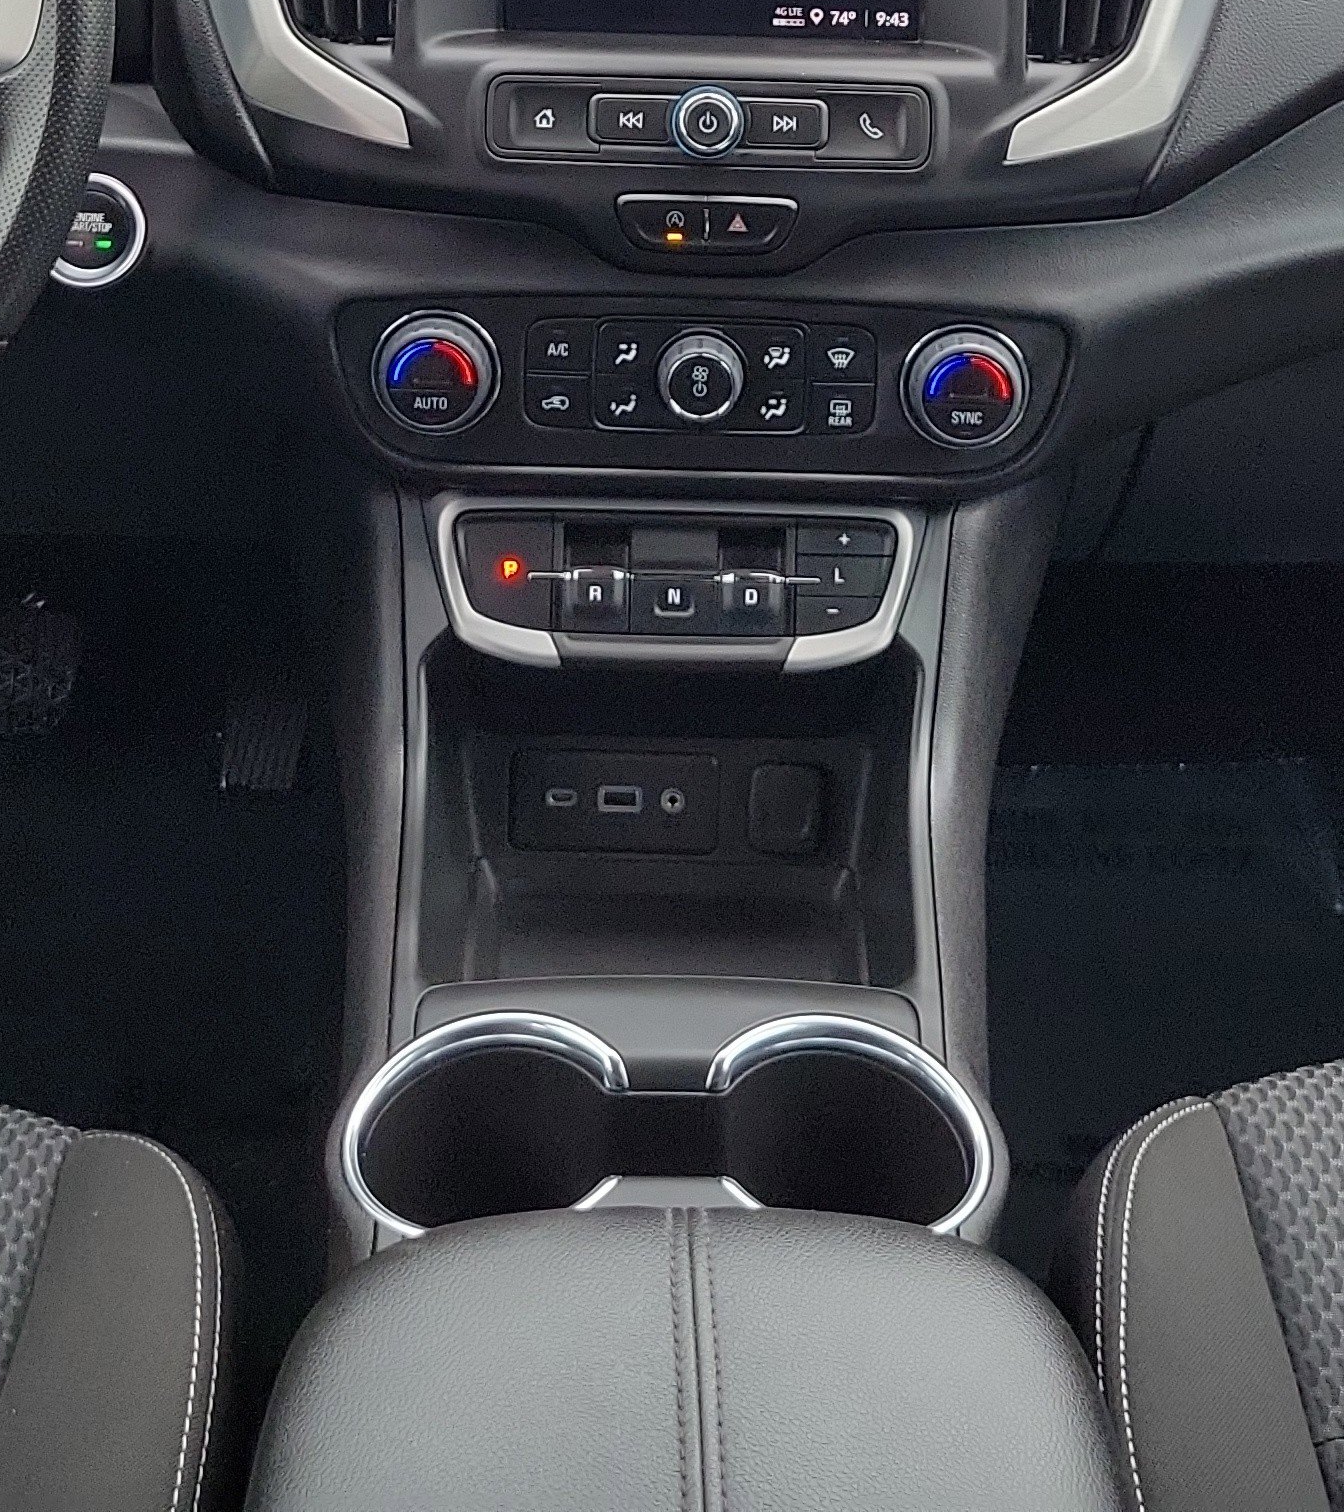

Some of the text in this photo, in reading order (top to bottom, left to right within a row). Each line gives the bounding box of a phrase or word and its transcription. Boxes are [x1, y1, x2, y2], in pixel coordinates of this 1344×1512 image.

[774, 7, 804, 17] 4G LTE
[875, 11, 910, 27] 9:43
[547, 342, 569, 357] A/C
[413, 396, 448, 411] AUTO
[827, 415, 853, 428] REAR
[950, 410, 984, 426] SYNC
[502, 559, 519, 579] P
[833, 566, 846, 585] L
[588, 584, 603, 603] R
[667, 587, 682, 606] N
[744, 588, 759, 606] D
